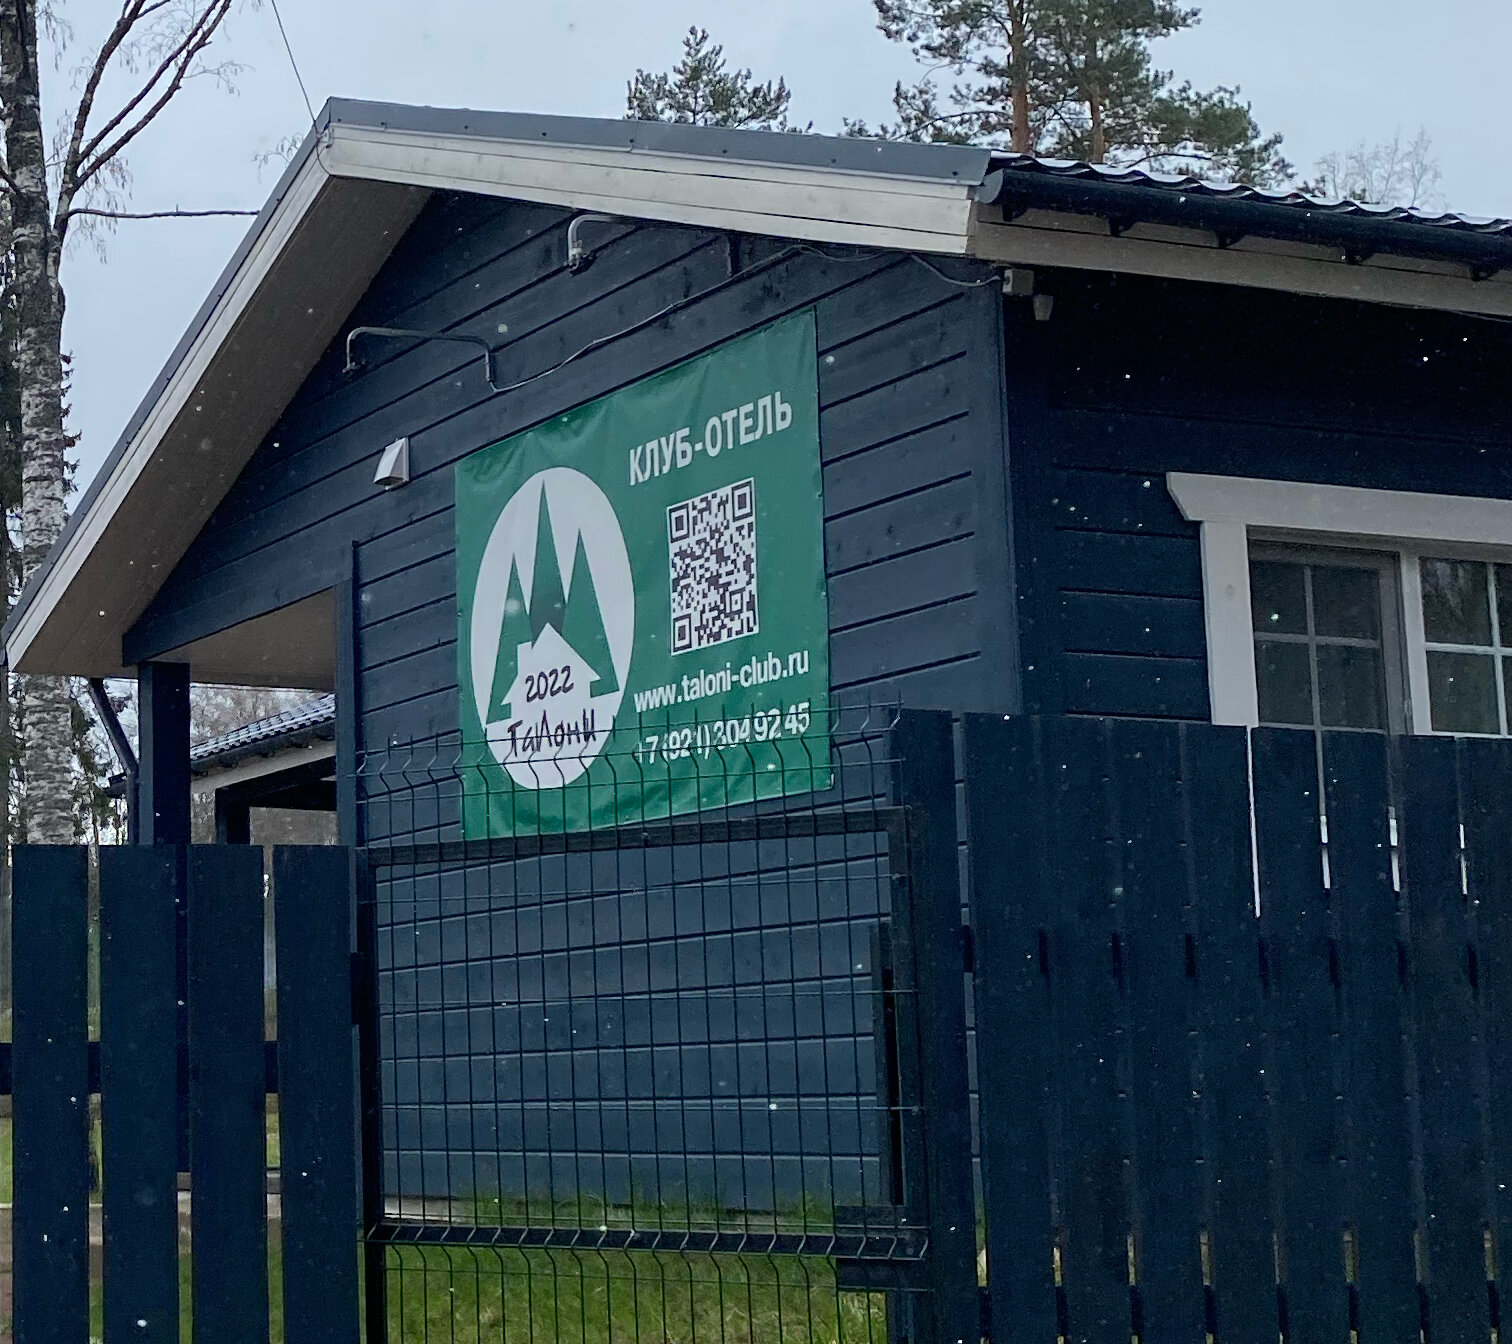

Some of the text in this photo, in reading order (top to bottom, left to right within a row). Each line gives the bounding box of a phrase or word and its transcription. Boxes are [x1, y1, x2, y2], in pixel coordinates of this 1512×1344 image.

[629, 391, 793, 486] КЛУБ-ОТЕЛЬ
[524, 665, 575, 703] 2022
[633, 650, 809, 713] www.taloni-club.ru
